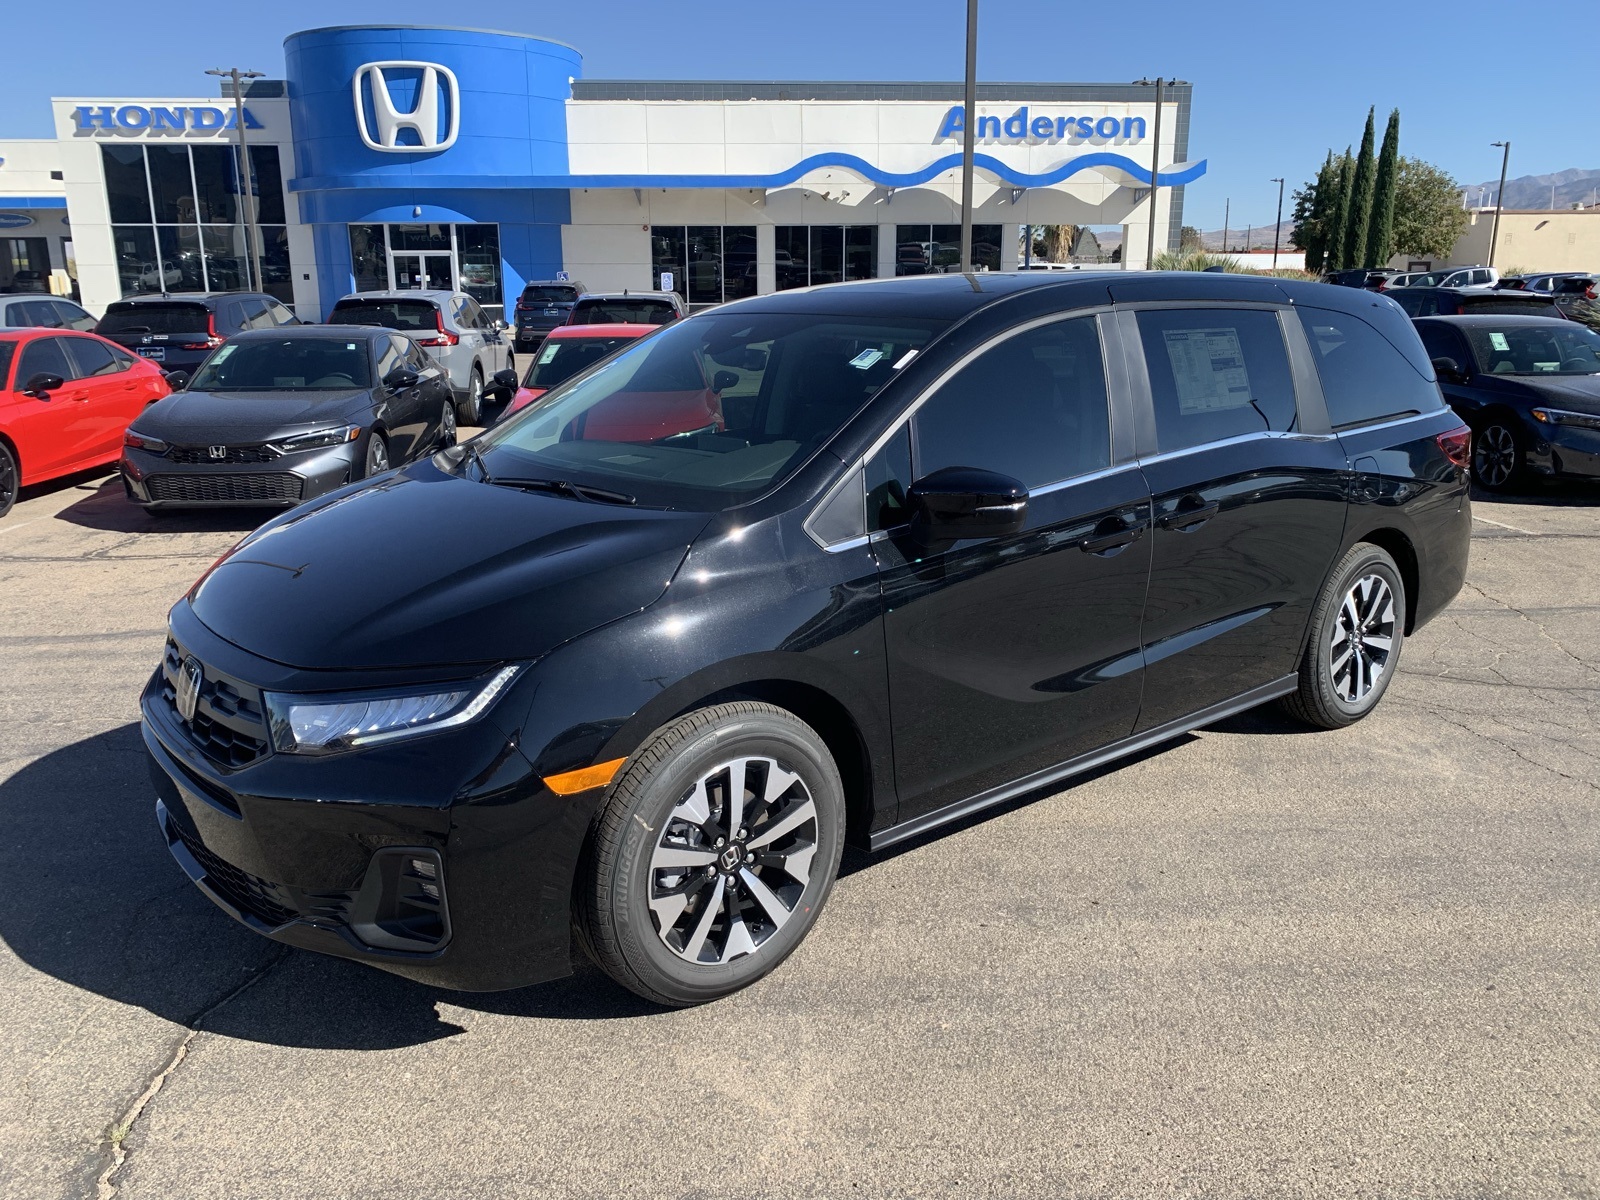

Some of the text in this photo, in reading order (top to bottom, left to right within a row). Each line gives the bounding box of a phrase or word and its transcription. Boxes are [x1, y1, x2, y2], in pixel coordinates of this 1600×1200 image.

[76, 105, 265, 130] HONDA
[939, 105, 1147, 139] Anderson
[410, 234, 463, 242] WELCOE
